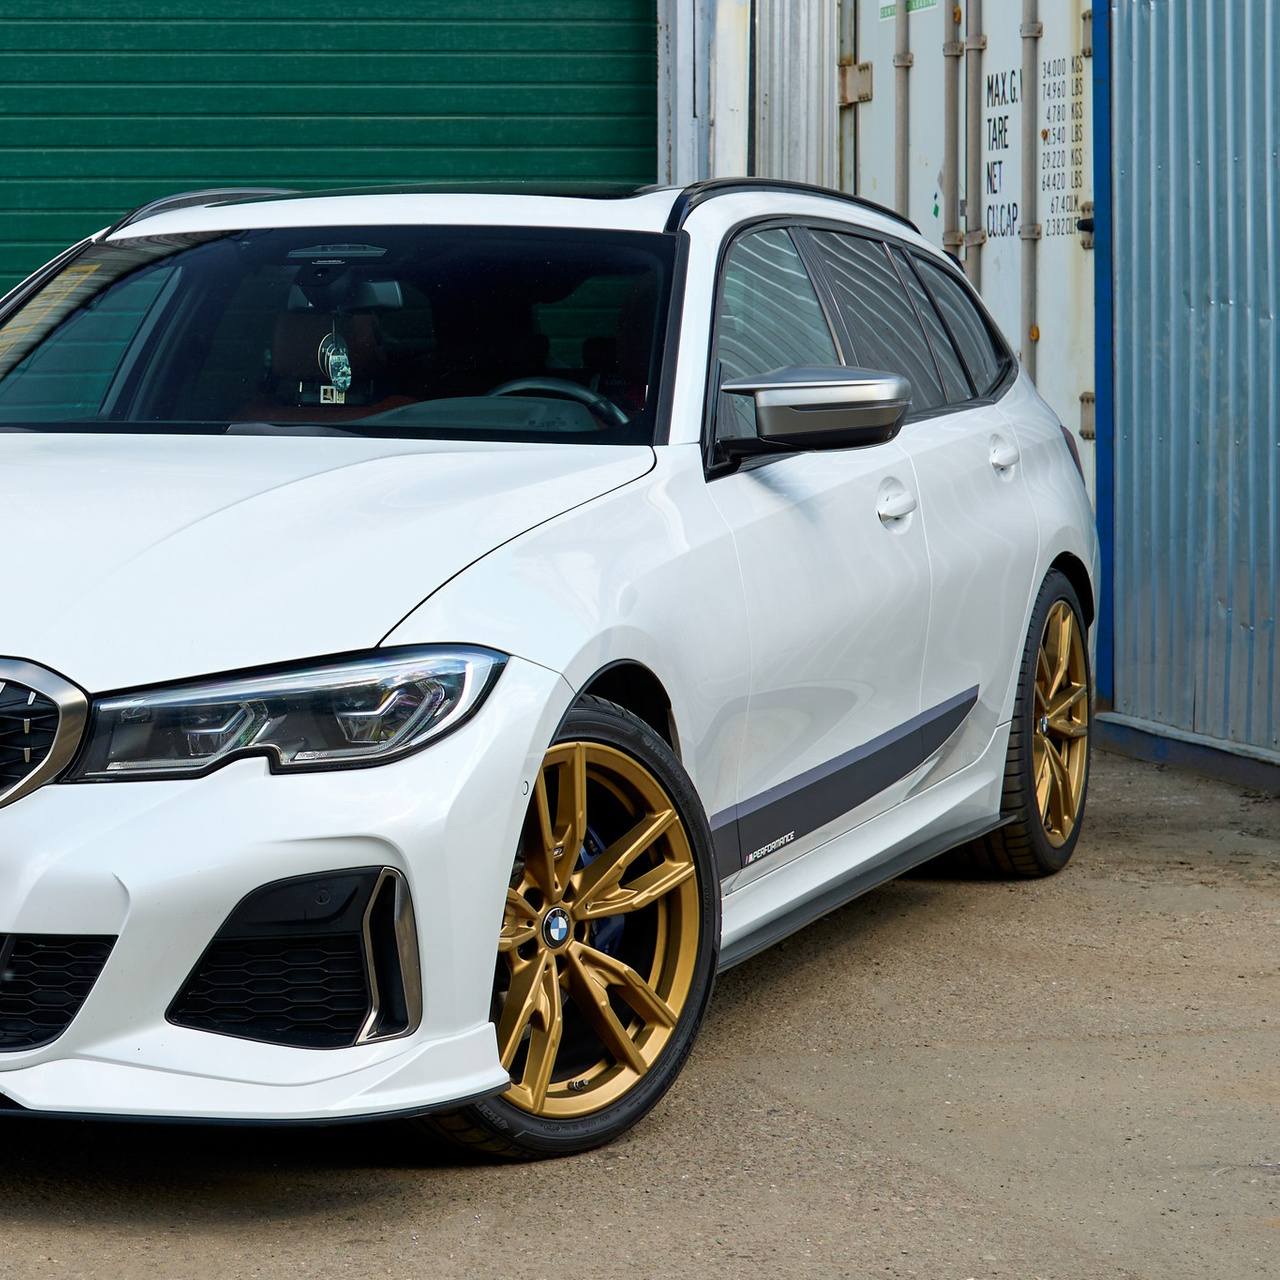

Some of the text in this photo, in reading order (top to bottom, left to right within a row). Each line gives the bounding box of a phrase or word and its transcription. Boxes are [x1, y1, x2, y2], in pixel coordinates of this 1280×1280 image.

[987, 55, 1083, 108] MAX.G. 34.000 KGS
[1071, 77, 1083, 96] LBS
[987, 115, 1008, 151] TARE
[1071, 101, 1083, 120] KGS
[1071, 123, 1083, 143] LBS
[987, 160, 1003, 194] NET
[1071, 148, 1082, 166] KGS
[1071, 170, 1082, 189] LBS
